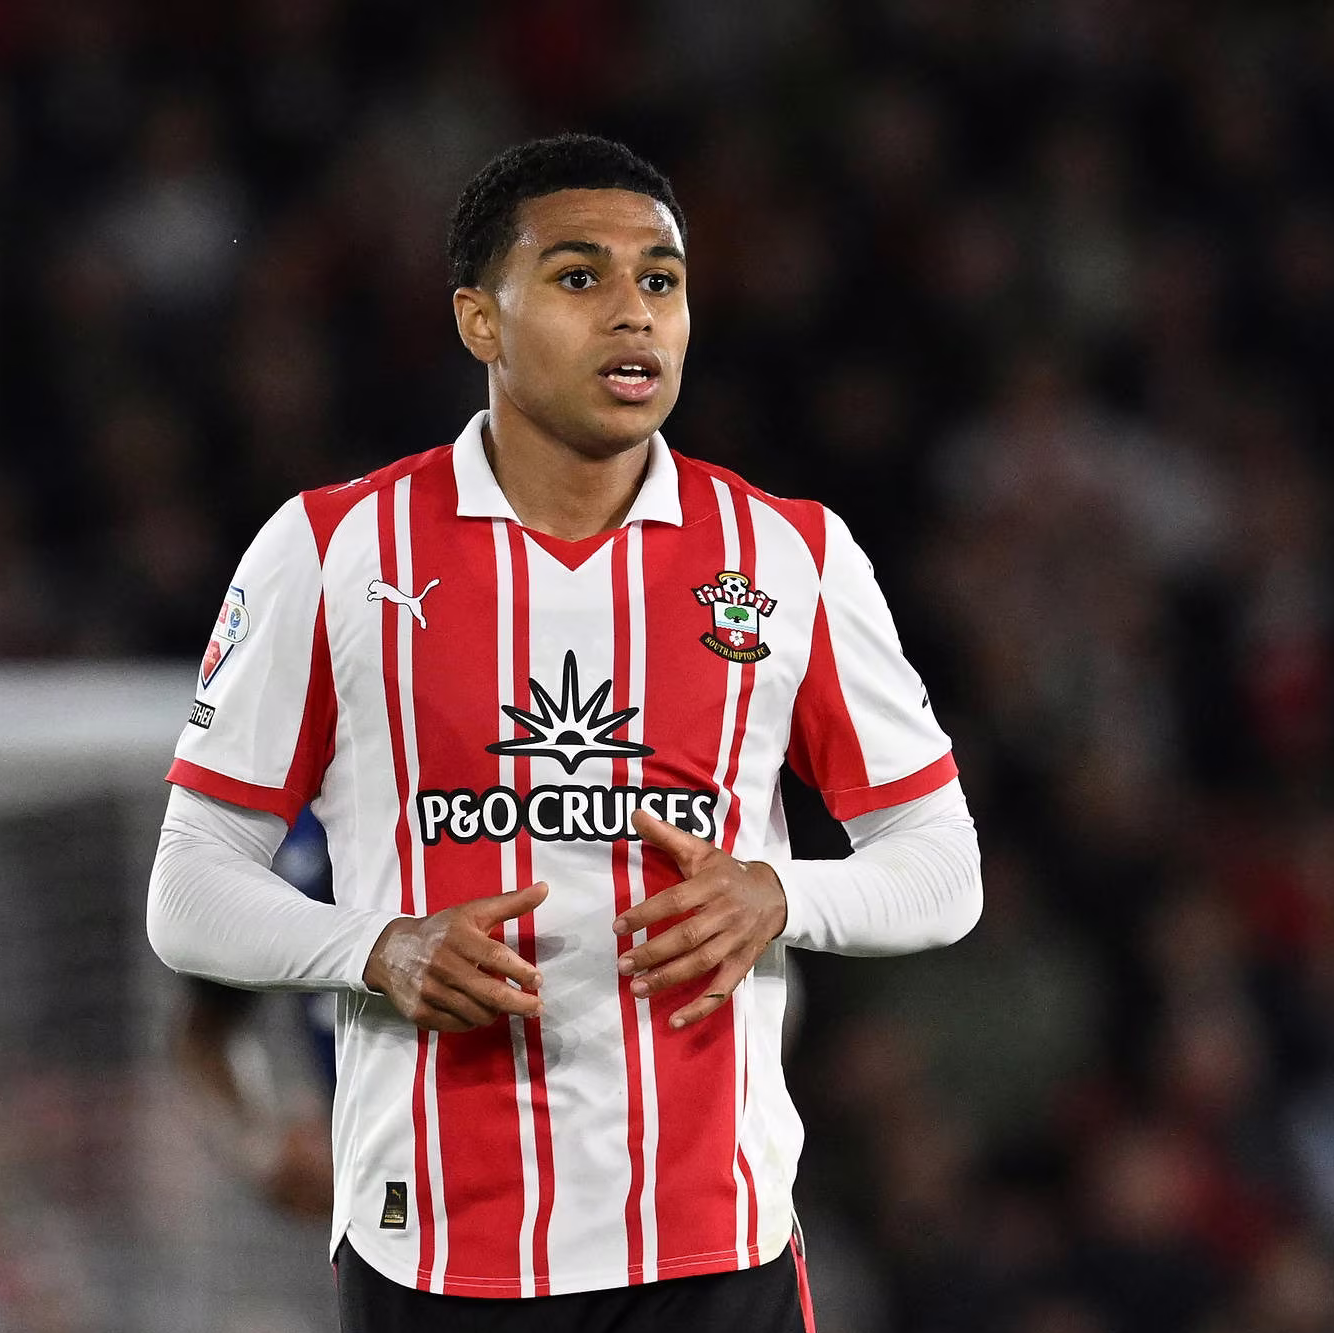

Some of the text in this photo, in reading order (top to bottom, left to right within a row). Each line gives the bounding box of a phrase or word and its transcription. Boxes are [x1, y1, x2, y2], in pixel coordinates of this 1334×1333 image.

[705, 637, 766, 660] SOUTHAMPTON FC
[422, 791, 518, 840] P&O
